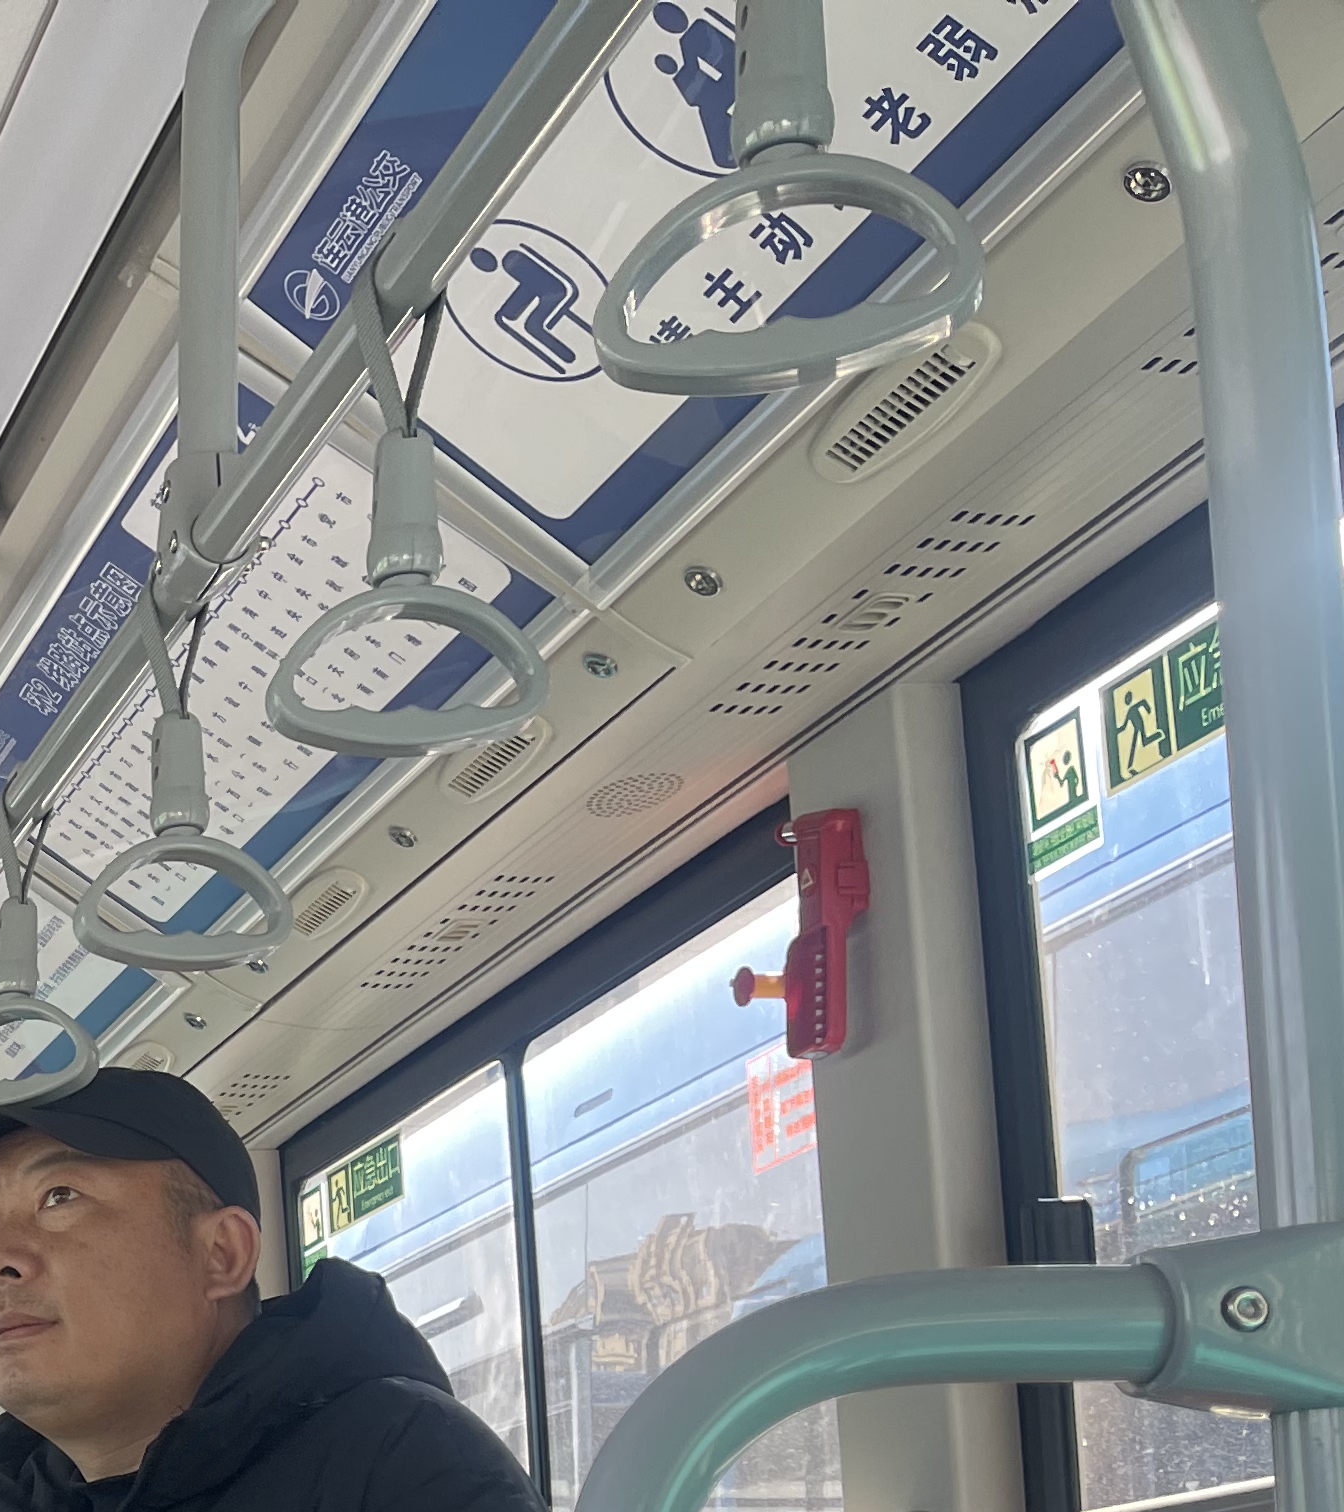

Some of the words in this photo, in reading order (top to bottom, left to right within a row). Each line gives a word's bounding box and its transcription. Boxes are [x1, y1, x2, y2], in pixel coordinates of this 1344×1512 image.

[311, 149, 411, 275] 连云港公交
[354, 1142, 401, 1198] 应急出口
